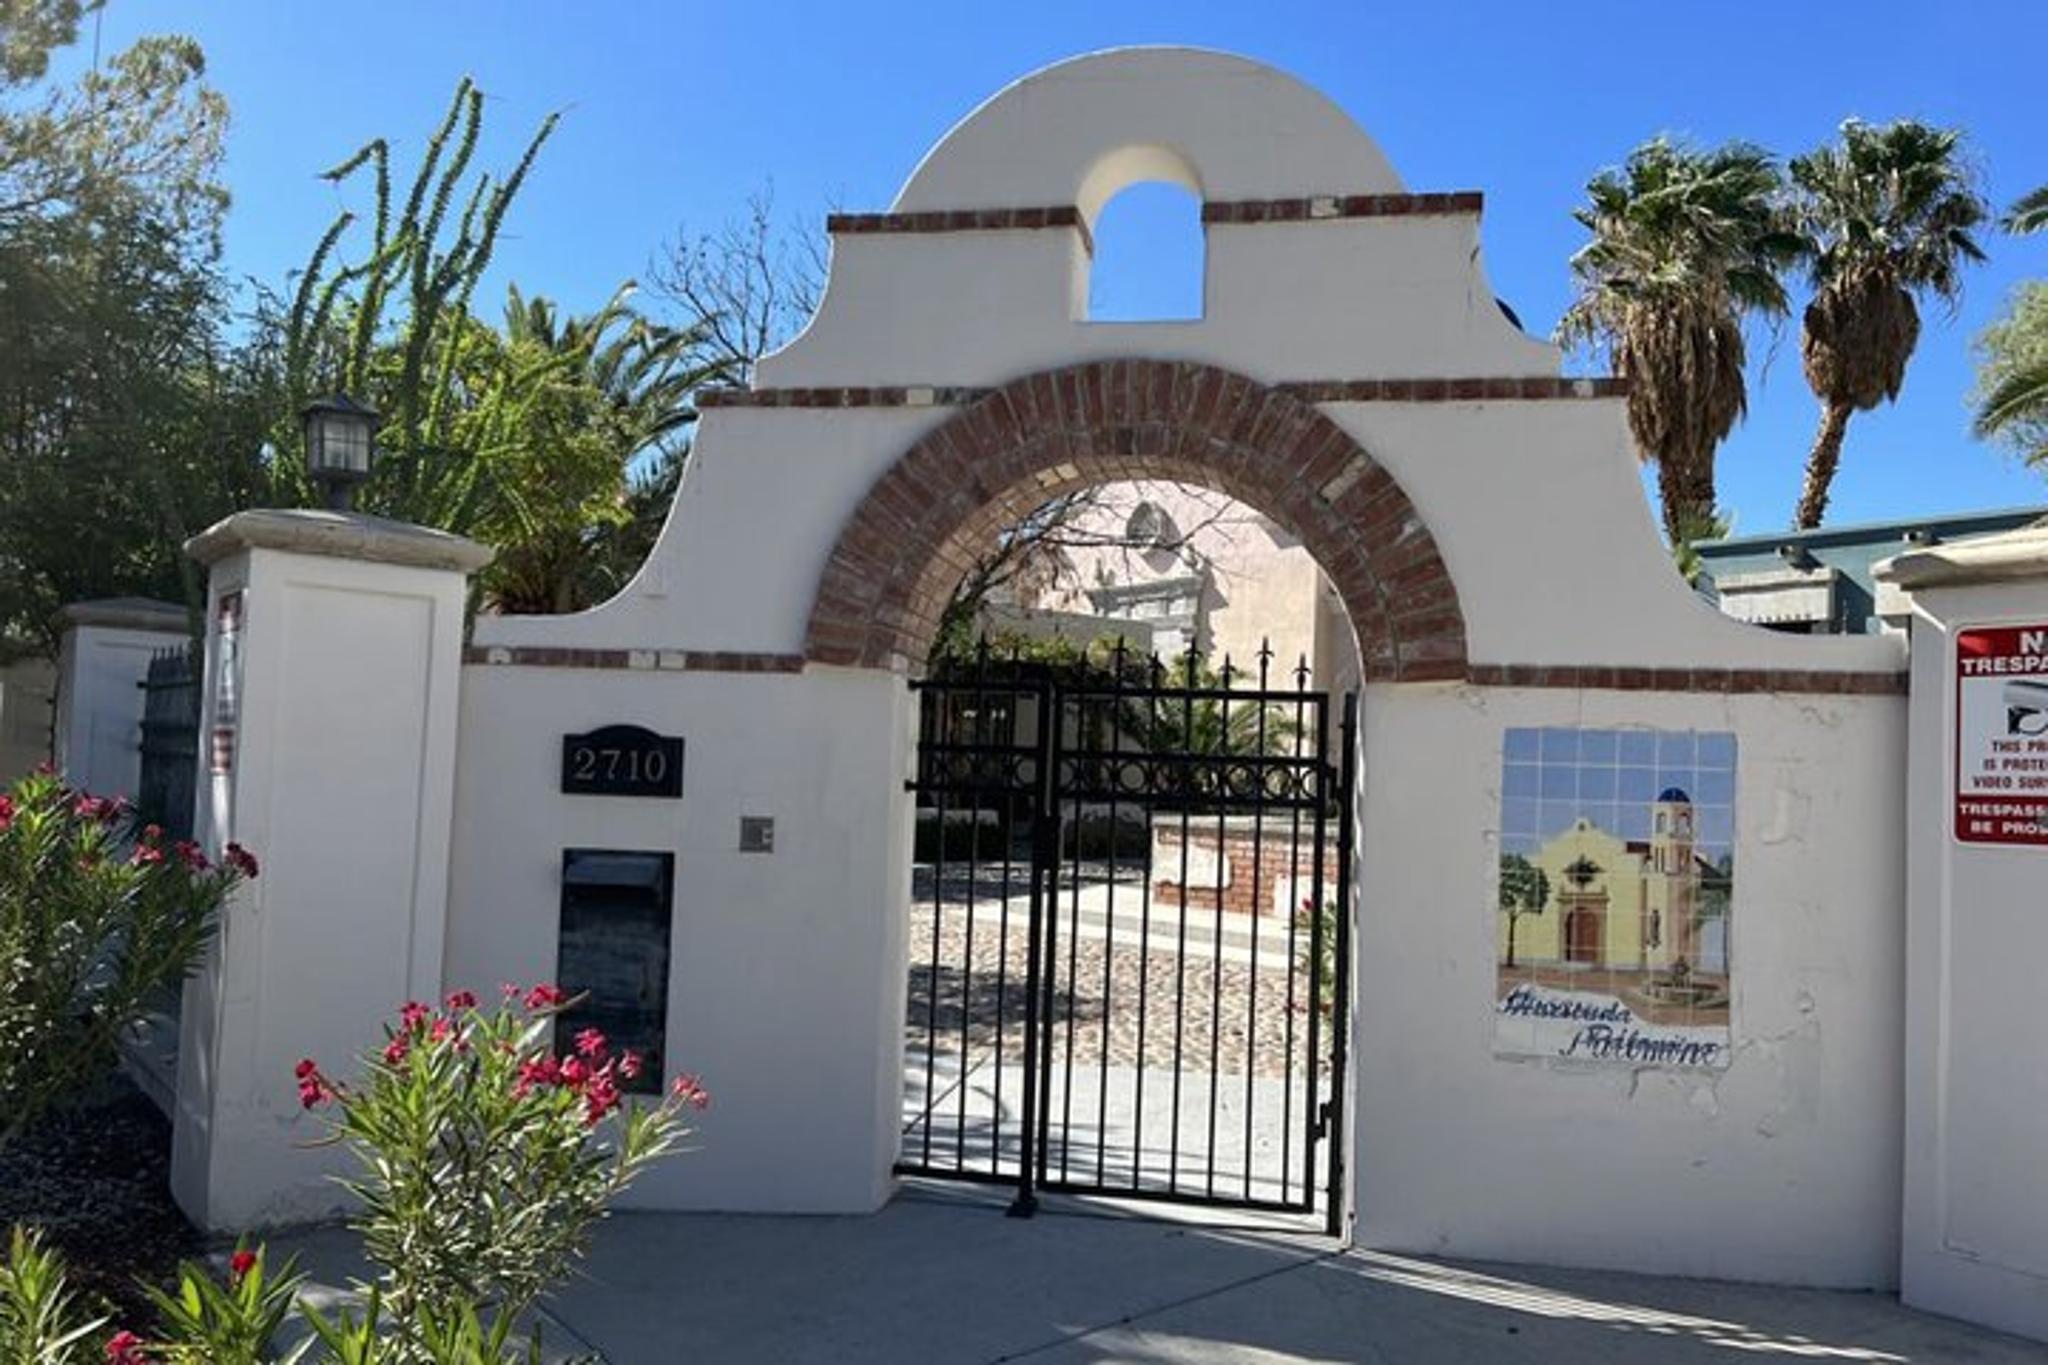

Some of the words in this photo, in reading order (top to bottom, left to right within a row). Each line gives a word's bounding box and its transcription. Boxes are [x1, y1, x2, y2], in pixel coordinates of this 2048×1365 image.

[1992, 740, 2020, 752] THIS
[573, 747, 667, 782] 2710
[1983, 758, 1997, 771] IS
[2002, 757, 2048, 771] PROTE
[1973, 776, 2013, 789] VIDEO
[1970, 821, 1993, 834] BE
